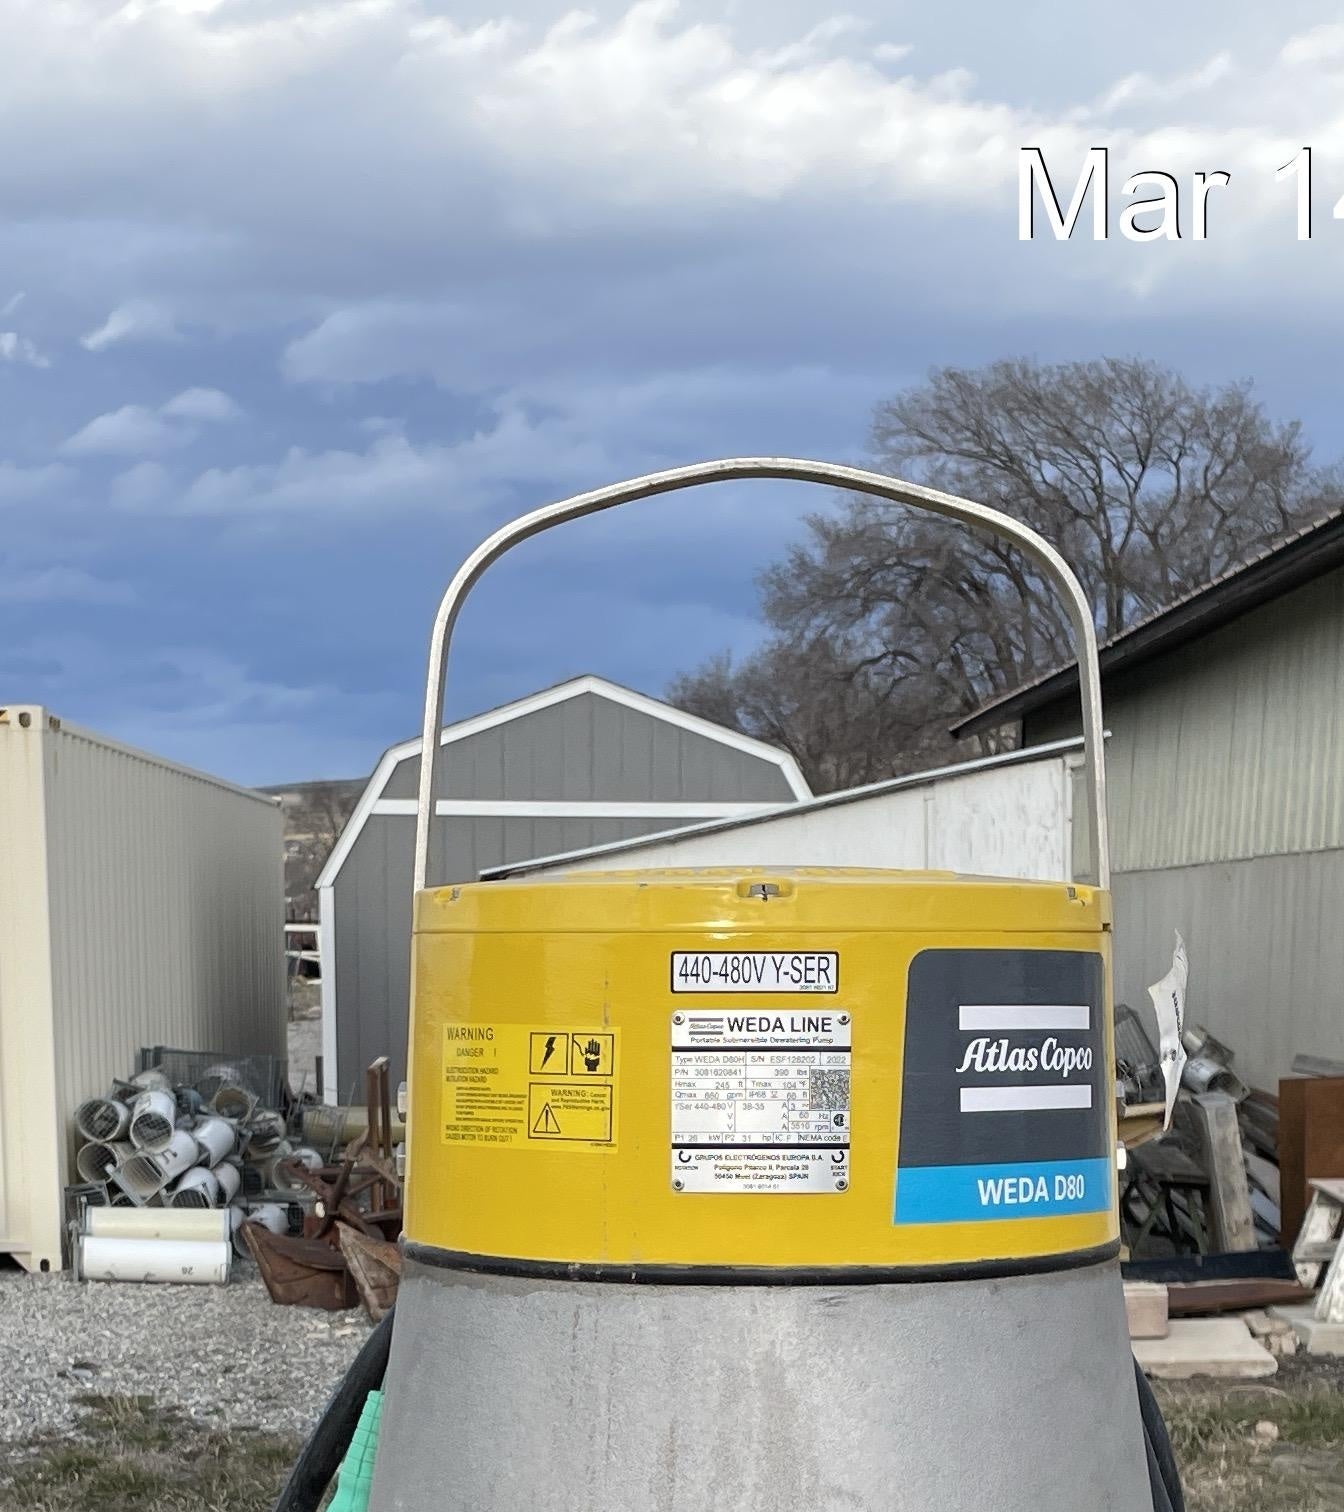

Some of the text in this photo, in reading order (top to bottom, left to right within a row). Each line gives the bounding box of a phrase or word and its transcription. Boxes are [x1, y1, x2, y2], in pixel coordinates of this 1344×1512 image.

[679, 956, 831, 983] 440-480V Y-SER
[728, 1017, 833, 1032] WEDA LINE
[447, 1028, 494, 1040] WARNING
[456, 1048, 484, 1057] DANGER
[675, 1056, 692, 1064] Type
[956, 1037, 1093, 1078] Atlas Copco
[978, 1174, 1084, 1206] WEDA D80
